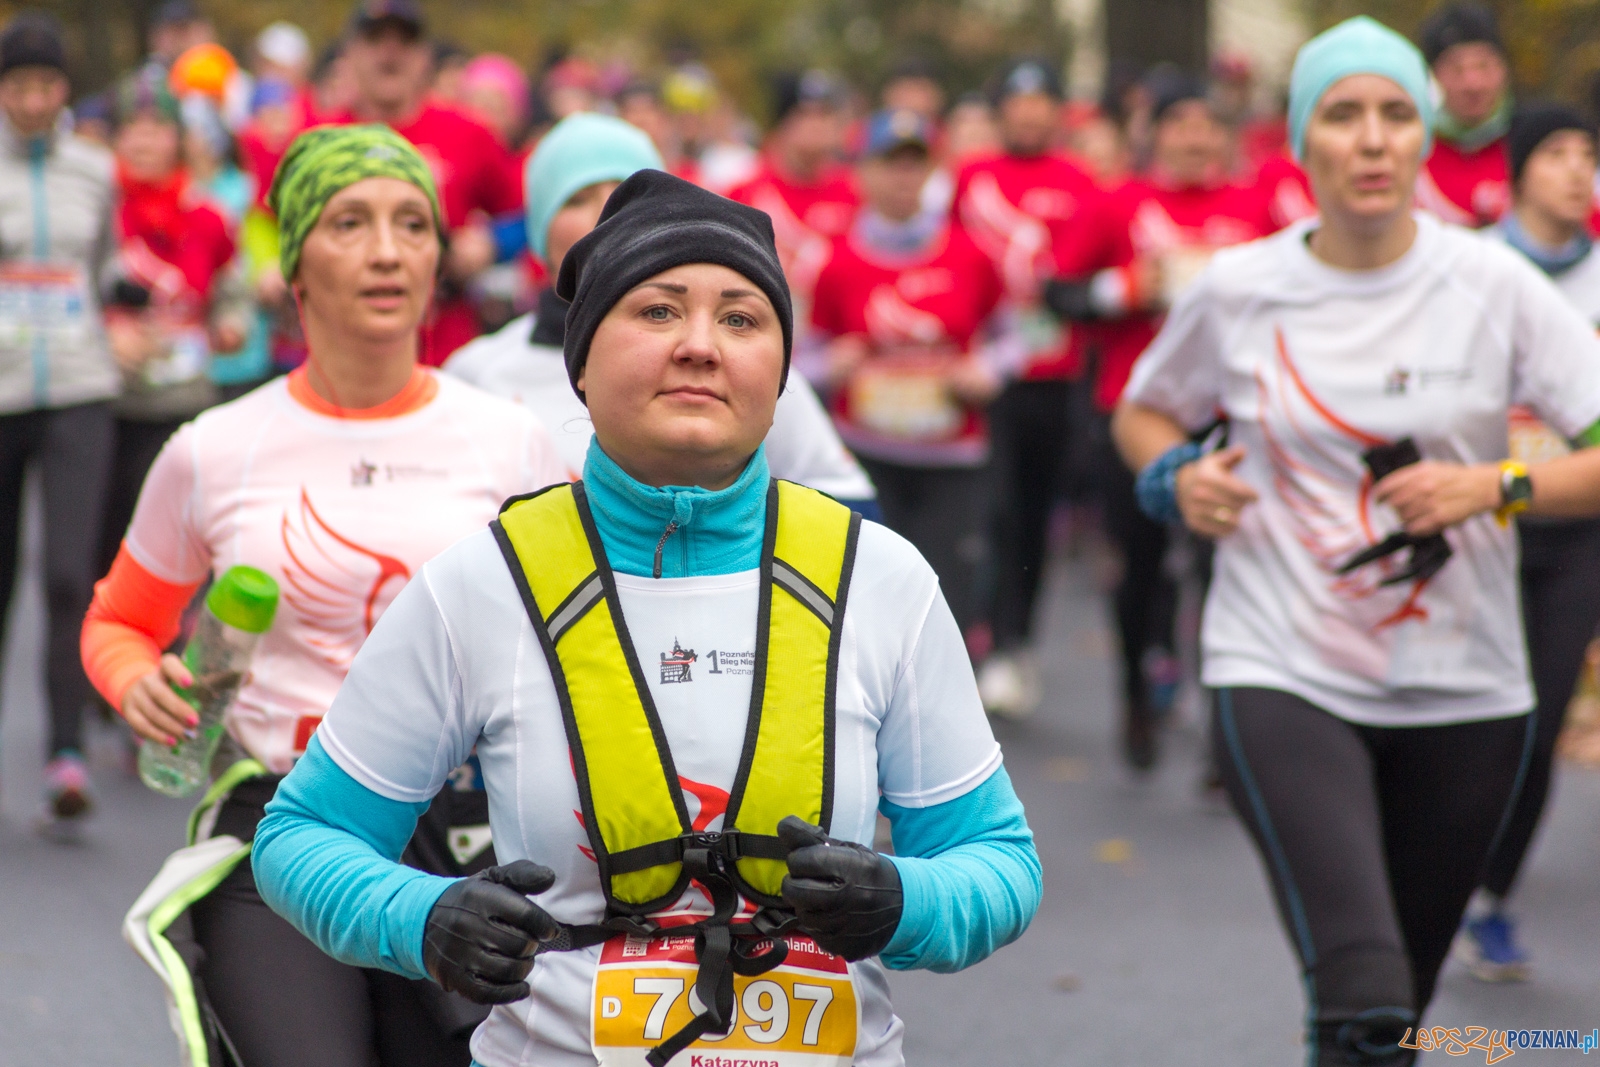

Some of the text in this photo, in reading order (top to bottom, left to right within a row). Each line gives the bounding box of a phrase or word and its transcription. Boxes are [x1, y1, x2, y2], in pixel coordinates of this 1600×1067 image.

[706, 649, 723, 674] 1
[720, 659, 739, 667] Bieg
[659, 936, 671, 950] 1
[602, 996, 622, 1018] D
[690, 1054, 780, 1067] Katarzyna
